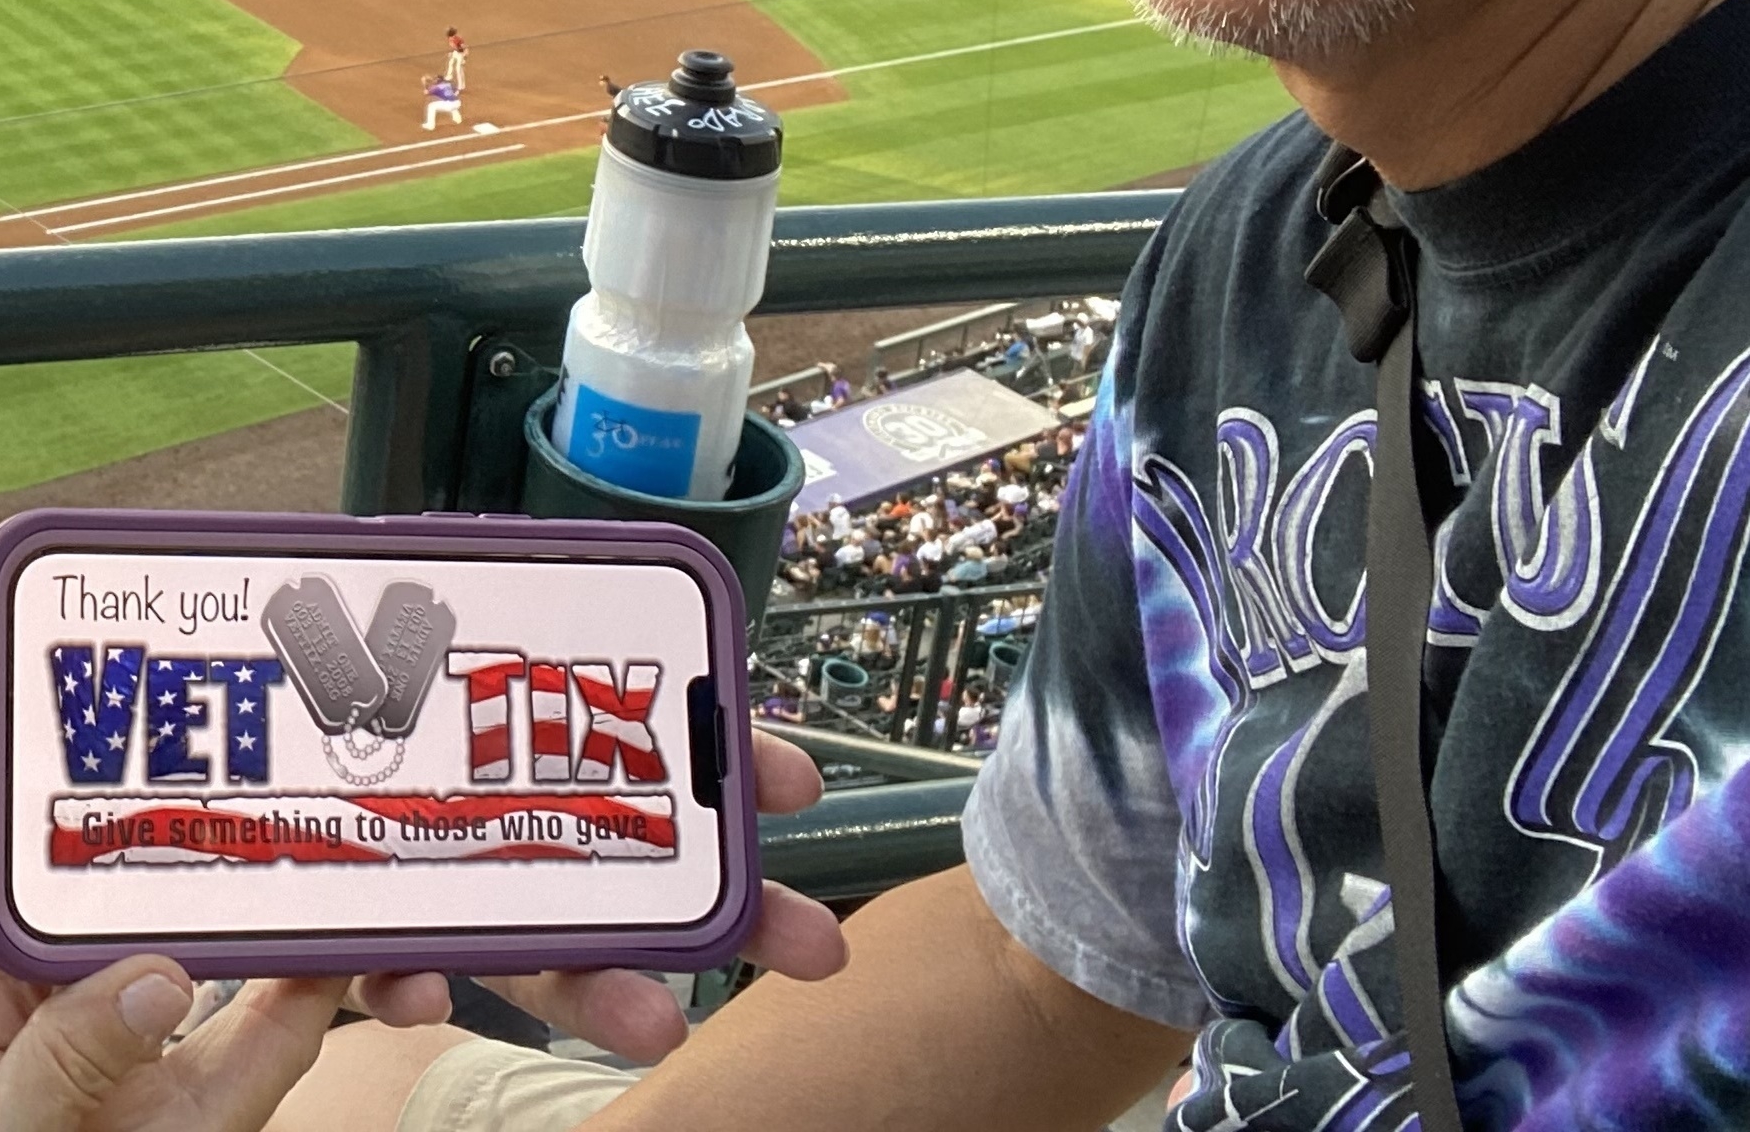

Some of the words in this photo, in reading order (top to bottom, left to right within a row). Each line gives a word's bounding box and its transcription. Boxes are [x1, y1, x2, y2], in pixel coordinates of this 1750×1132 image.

[53, 574, 165, 623] Thank
[178, 577, 250, 636] you!
[306, 602, 339, 646] ADMIT
[49, 644, 285, 785] VET
[444, 648, 671, 786] TIX
[81, 811, 155, 845] Give
[169, 809, 342, 849] something
[356, 811, 386, 843] to
[400, 809, 487, 842] those
[500, 809, 563, 842] who
[576, 813, 648, 846] gave
